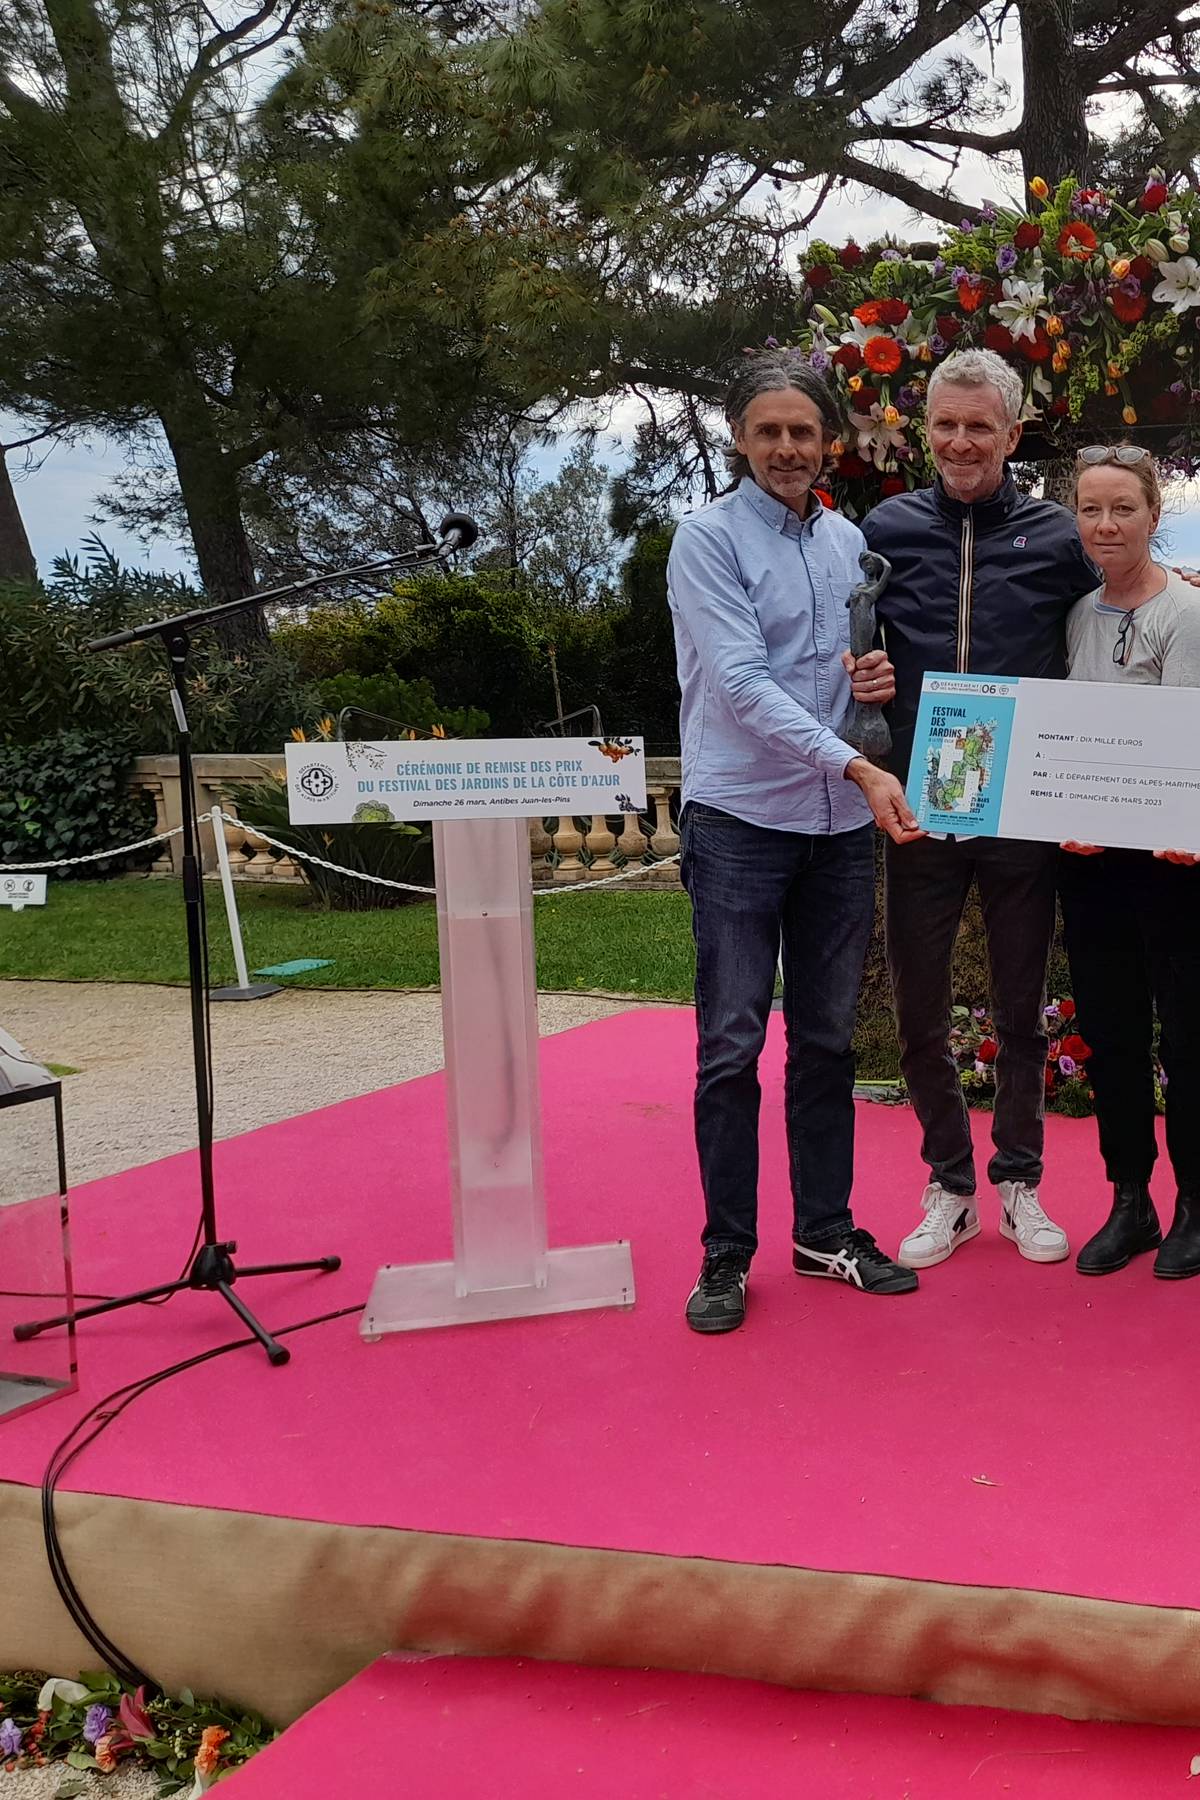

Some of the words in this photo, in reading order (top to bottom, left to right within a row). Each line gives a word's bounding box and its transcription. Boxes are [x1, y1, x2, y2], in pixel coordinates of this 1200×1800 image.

[981, 684, 997, 694] 06
[932, 706, 968, 718] FESTIVAL
[930, 716, 946, 727] DES
[929, 727, 962, 738] JARDINS
[1038, 733, 1075, 742] MONTANT
[1095, 737, 1116, 745] MILLE
[1117, 738, 1143, 747] EUROS
[396, 760, 462, 776] CÉRÉMONIE
[466, 762, 481, 775] DE
[485, 761, 527, 774] REMISE
[530, 760, 552, 773] DES
[555, 759, 583, 772] PRIX
[357, 780, 374, 793] DU
[379, 779, 432, 793] FESTIVAL
[435, 778, 457, 791] DES
[461, 777, 509, 790] JARDINS
[513, 777, 528, 789] DE
[531, 776, 545, 789] LA
[549, 773, 577, 788] CÔTE
[581, 774, 620, 787] D'AZUR
[1032, 770, 1048, 778] PAR
[1122, 777, 1137, 785] DES
[413, 799, 453, 808] Dimanche
[489, 797, 519, 805] Antibes
[520, 796, 571, 804] Juan-les-Pins
[1030, 789, 1053, 798] REMIS
[1054, 791, 1064, 799] LE
[1069, 793, 1109, 803] DIMANCHE
[1121, 797, 1143, 805] MARS
